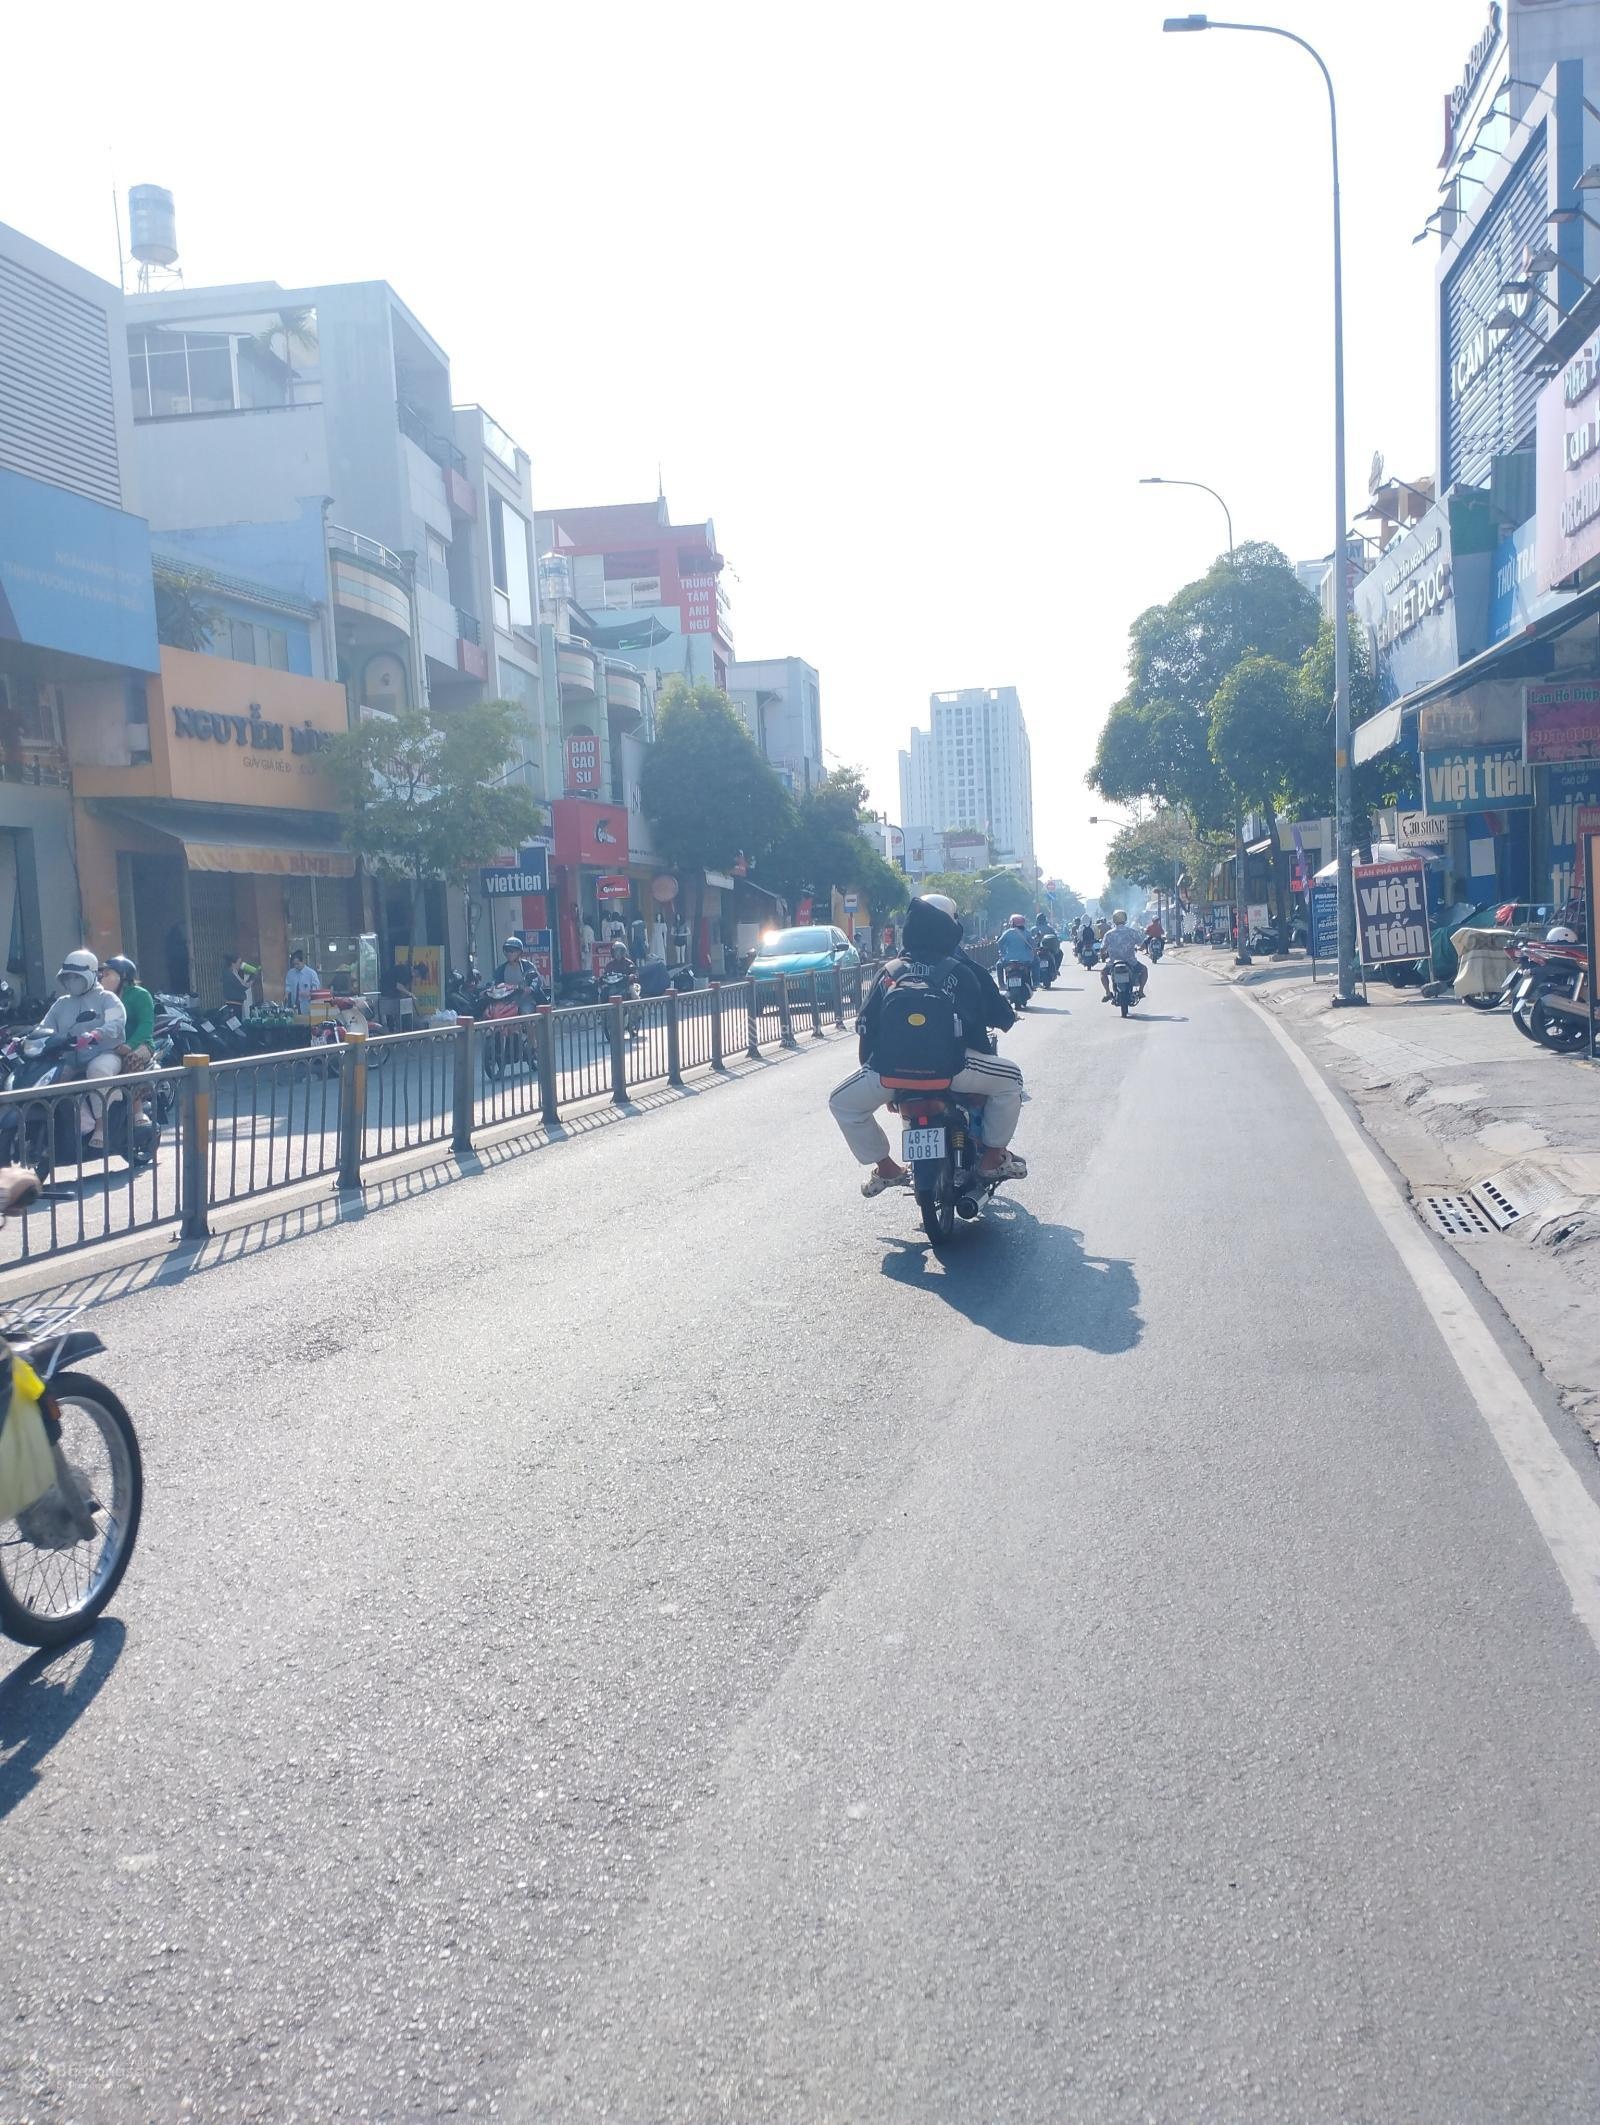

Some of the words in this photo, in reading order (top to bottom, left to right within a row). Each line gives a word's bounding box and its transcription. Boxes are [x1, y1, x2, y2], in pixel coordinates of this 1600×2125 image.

[1457, 327, 1484, 393] CAN
[680, 577, 713, 590] TRUNG
[688, 606, 709, 617] ANH
[172, 704, 284, 751] NGUYỄN
[572, 740, 595, 754] BAO
[572, 755, 595, 769] CAO
[576, 771, 592, 784] SU
[1429, 754, 1479, 810] việt
[1482, 749, 1532, 799] tiến
[1549, 792, 1598, 846] vi
[1400, 862, 1418, 873] MAY
[486, 872, 542, 893] viettien
[1360, 877, 1422, 920] việt
[1365, 917, 1426, 959] tiến
[909, 1130, 939, 1144] 48-F2
[909, 1144, 938, 1159] 0081
